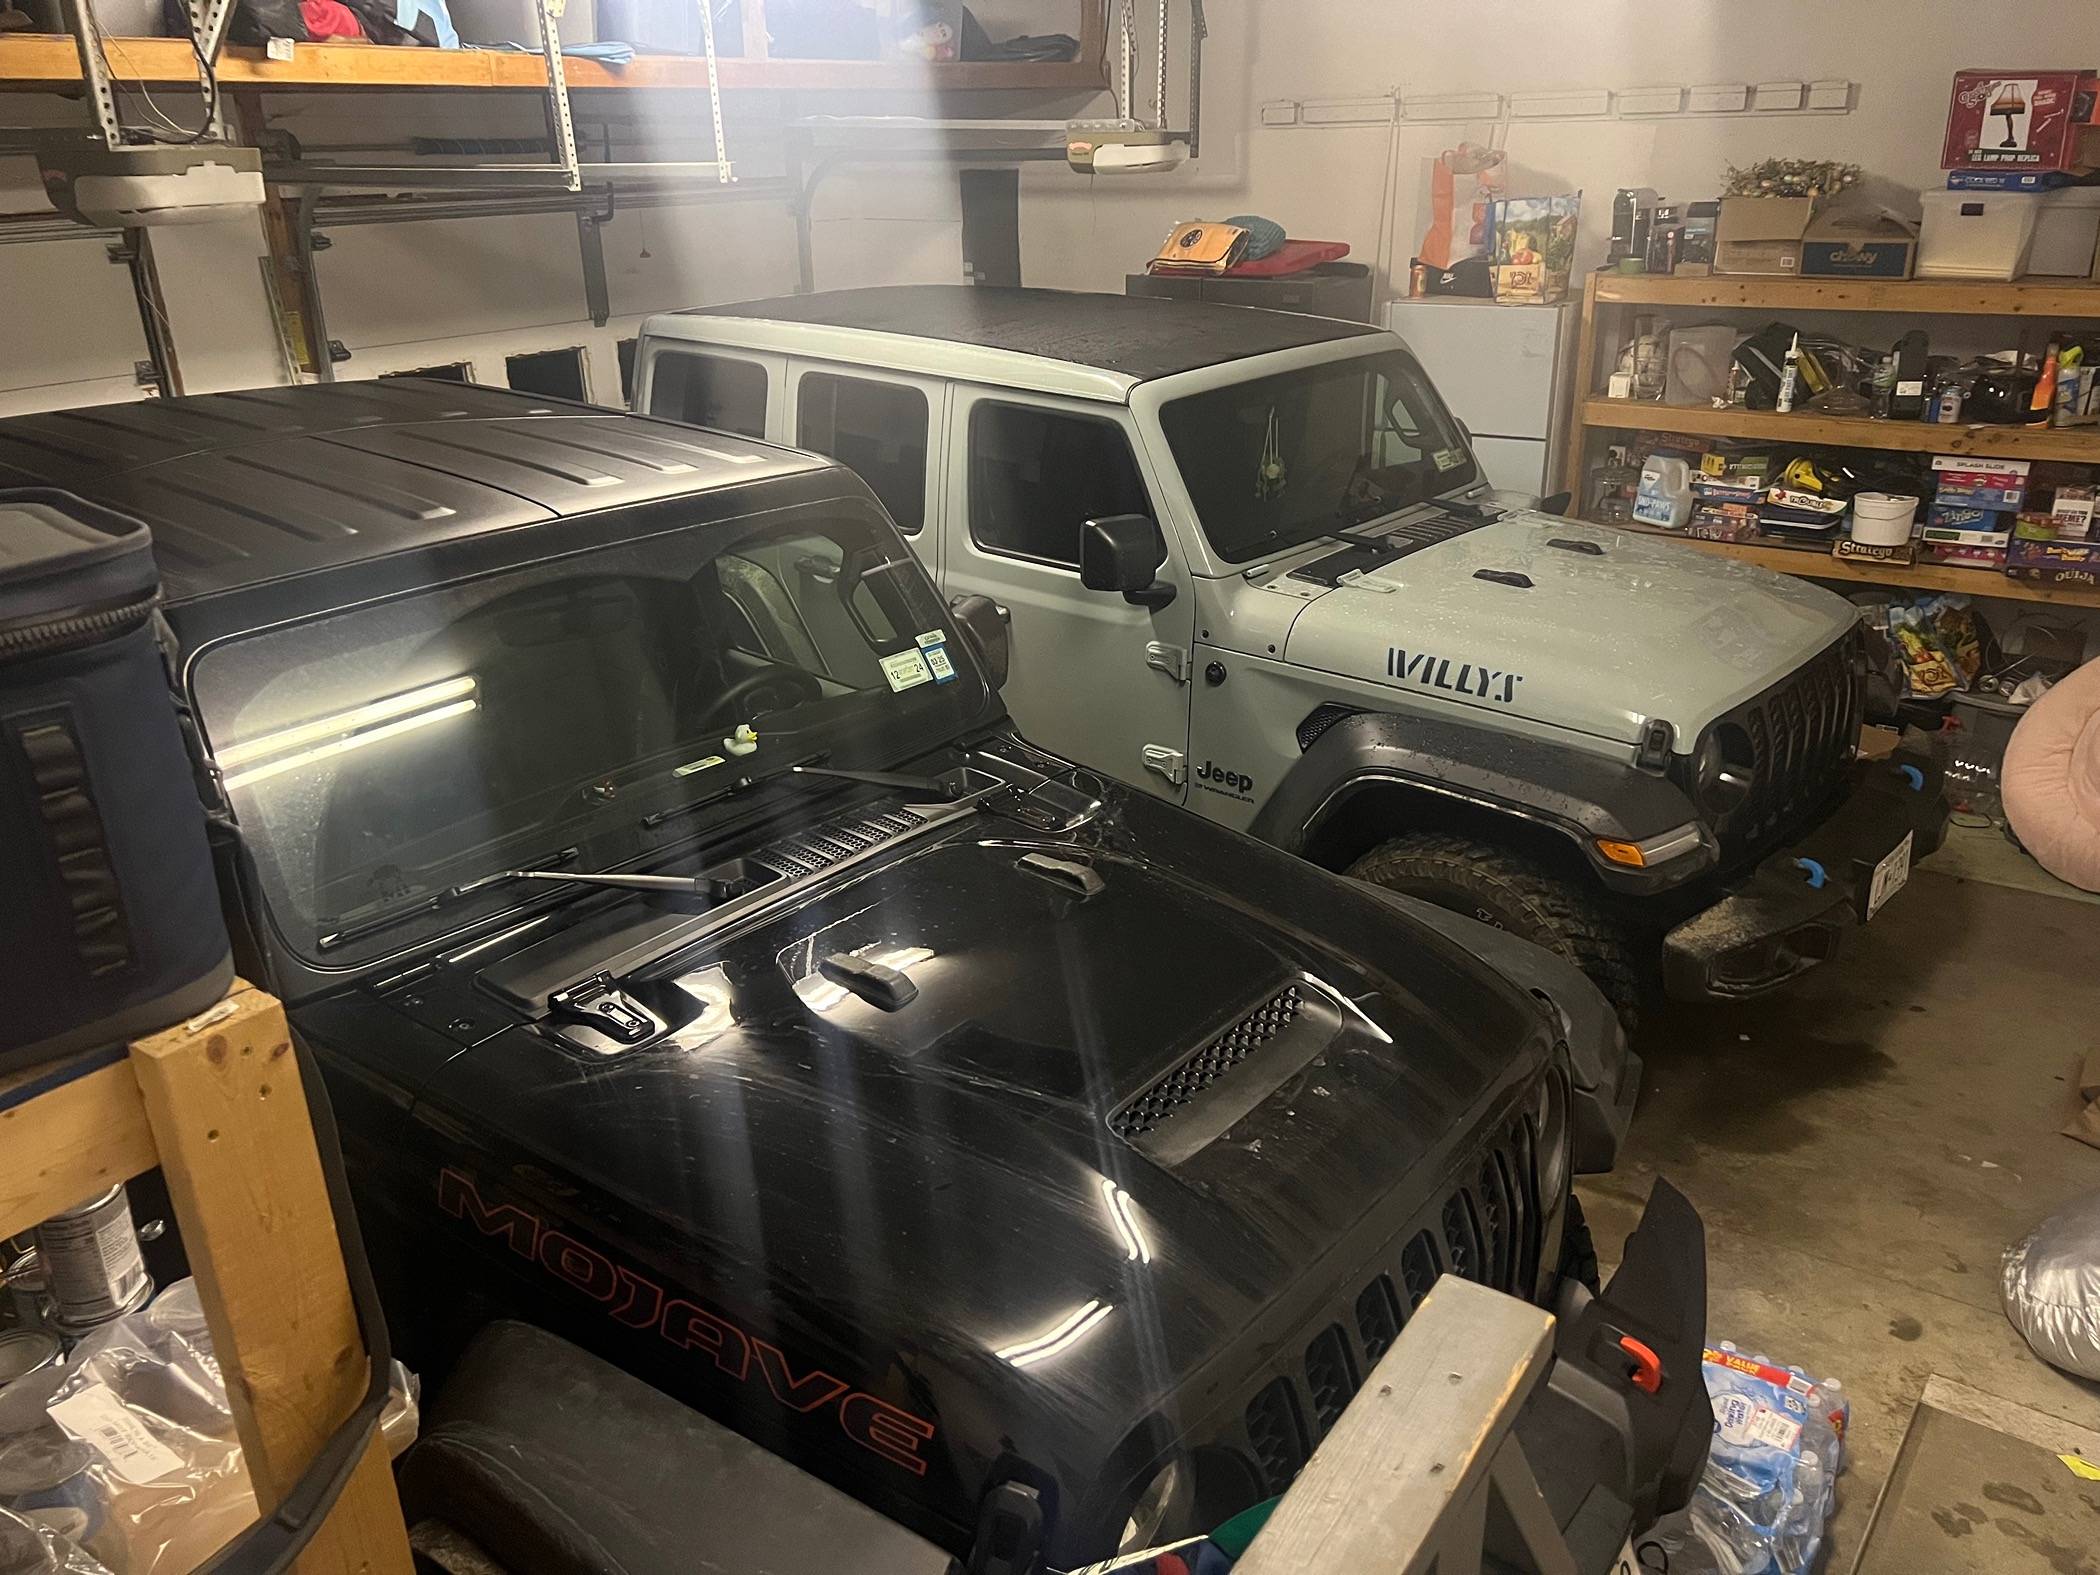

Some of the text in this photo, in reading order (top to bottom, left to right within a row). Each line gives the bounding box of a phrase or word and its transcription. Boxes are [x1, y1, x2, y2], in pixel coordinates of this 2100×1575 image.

[1983, 154, 2000, 162] LAMP
[1956, 461, 1983, 469] SPLASH
[1789, 495, 1824, 509] TROUBLE
[1840, 541, 1893, 559] Stratego
[2055, 570, 2095, 585] OUIJA
[891, 670, 901, 680] 12
[1387, 647, 1524, 703] WILLYS
[1196, 760, 1254, 793] Jeep
[438, 1167, 936, 1476] MOJAVE
